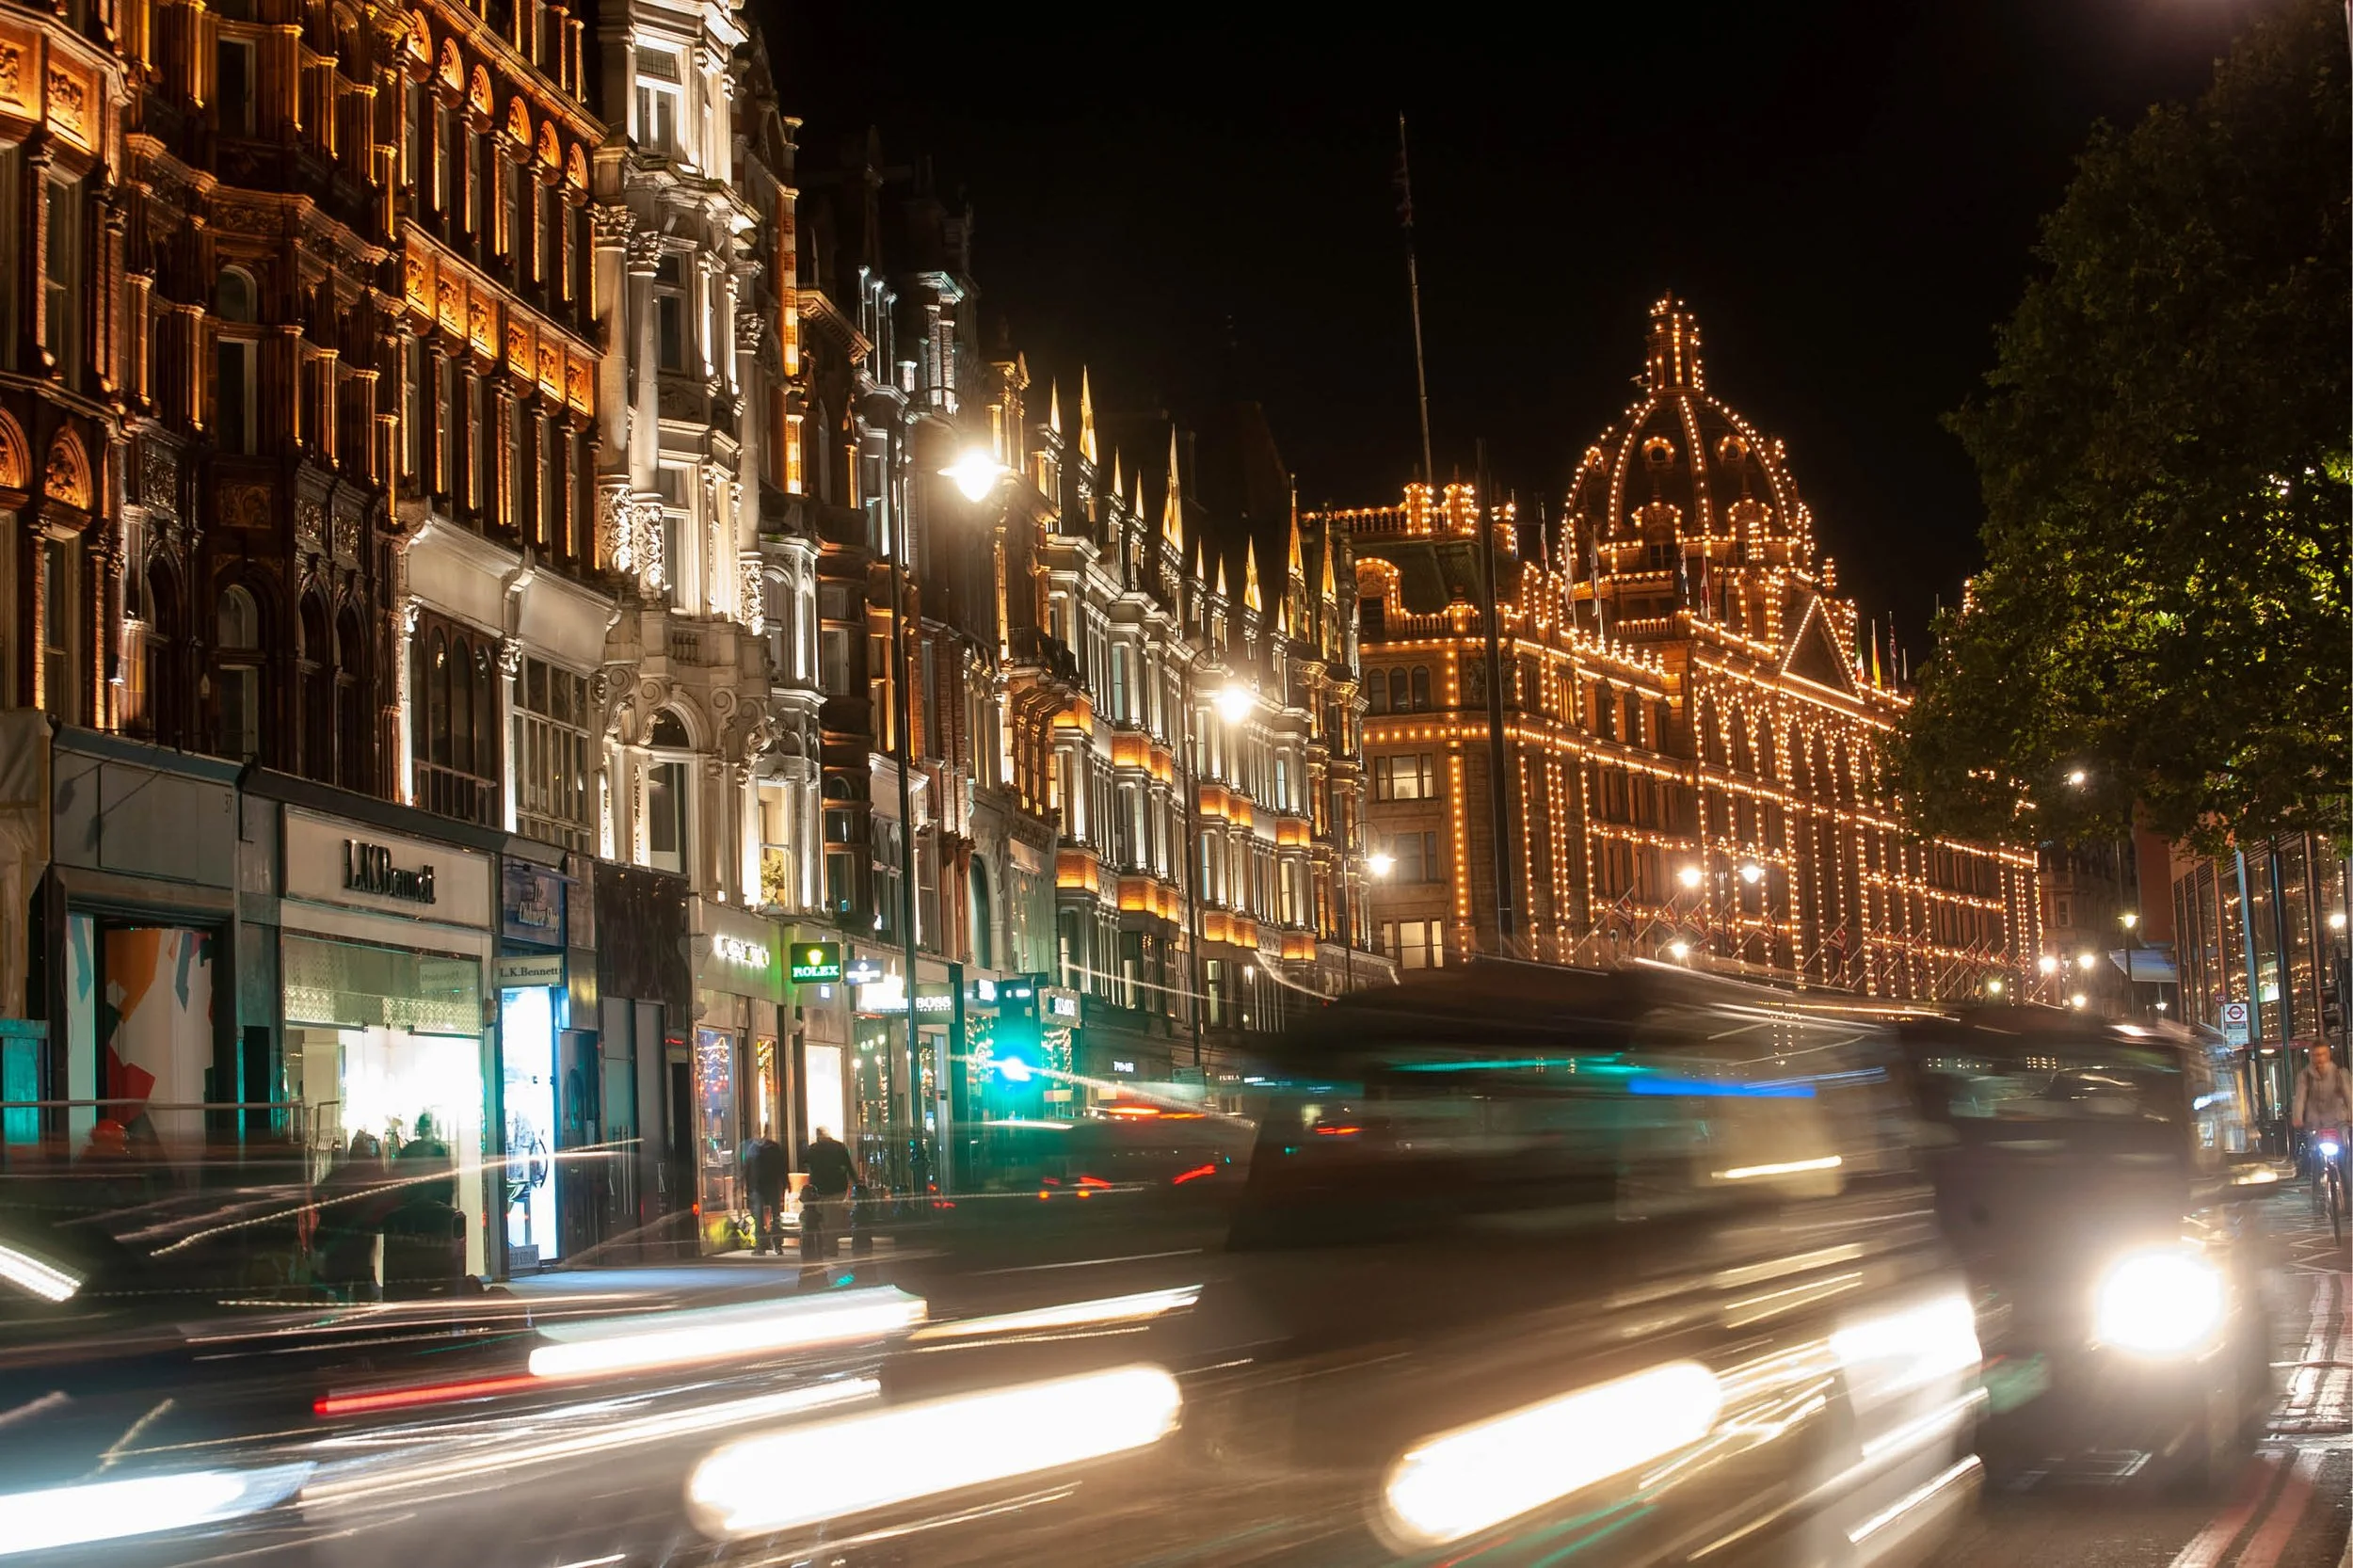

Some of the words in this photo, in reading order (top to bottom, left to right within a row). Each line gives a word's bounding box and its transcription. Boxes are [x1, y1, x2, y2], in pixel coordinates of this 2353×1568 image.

[500, 966, 558, 978] L.K.Bennett
[792, 965, 840, 978] ROLEX
[916, 996, 952, 1008] BOSS
